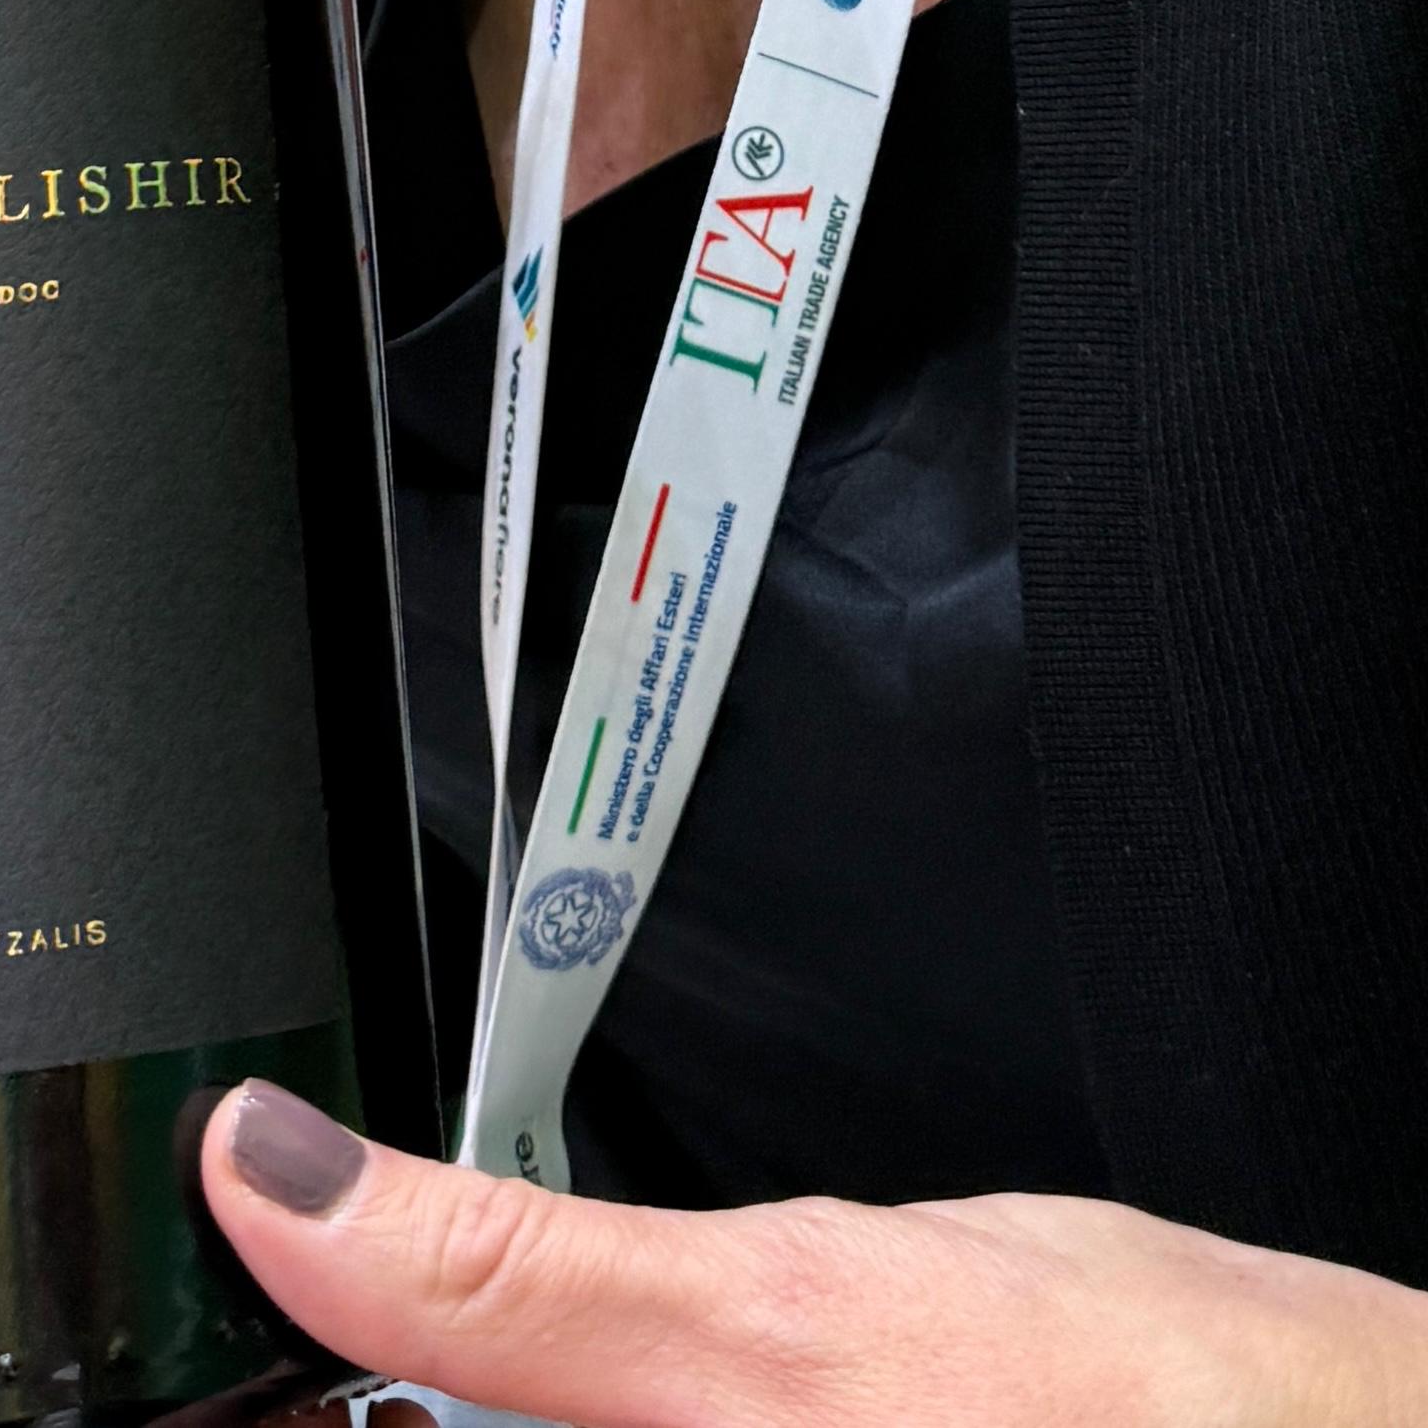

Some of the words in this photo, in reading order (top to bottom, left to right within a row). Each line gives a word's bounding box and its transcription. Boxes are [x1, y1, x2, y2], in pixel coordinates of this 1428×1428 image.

[777, 333, 812, 405] ITALIAN
[797, 271, 830, 333] TRADE
[816, 194, 851, 271] AGENCY
[656, 571, 688, 632] Esteri
[682, 499, 738, 643] Internazionale
[639, 633, 669, 693] Affari
[627, 696, 655, 745] degli
[643, 645, 697, 778] Cooperazione
[597, 747, 637, 840] Ministero
[631, 780, 655, 829] della
[626, 829, 640, 844] e
